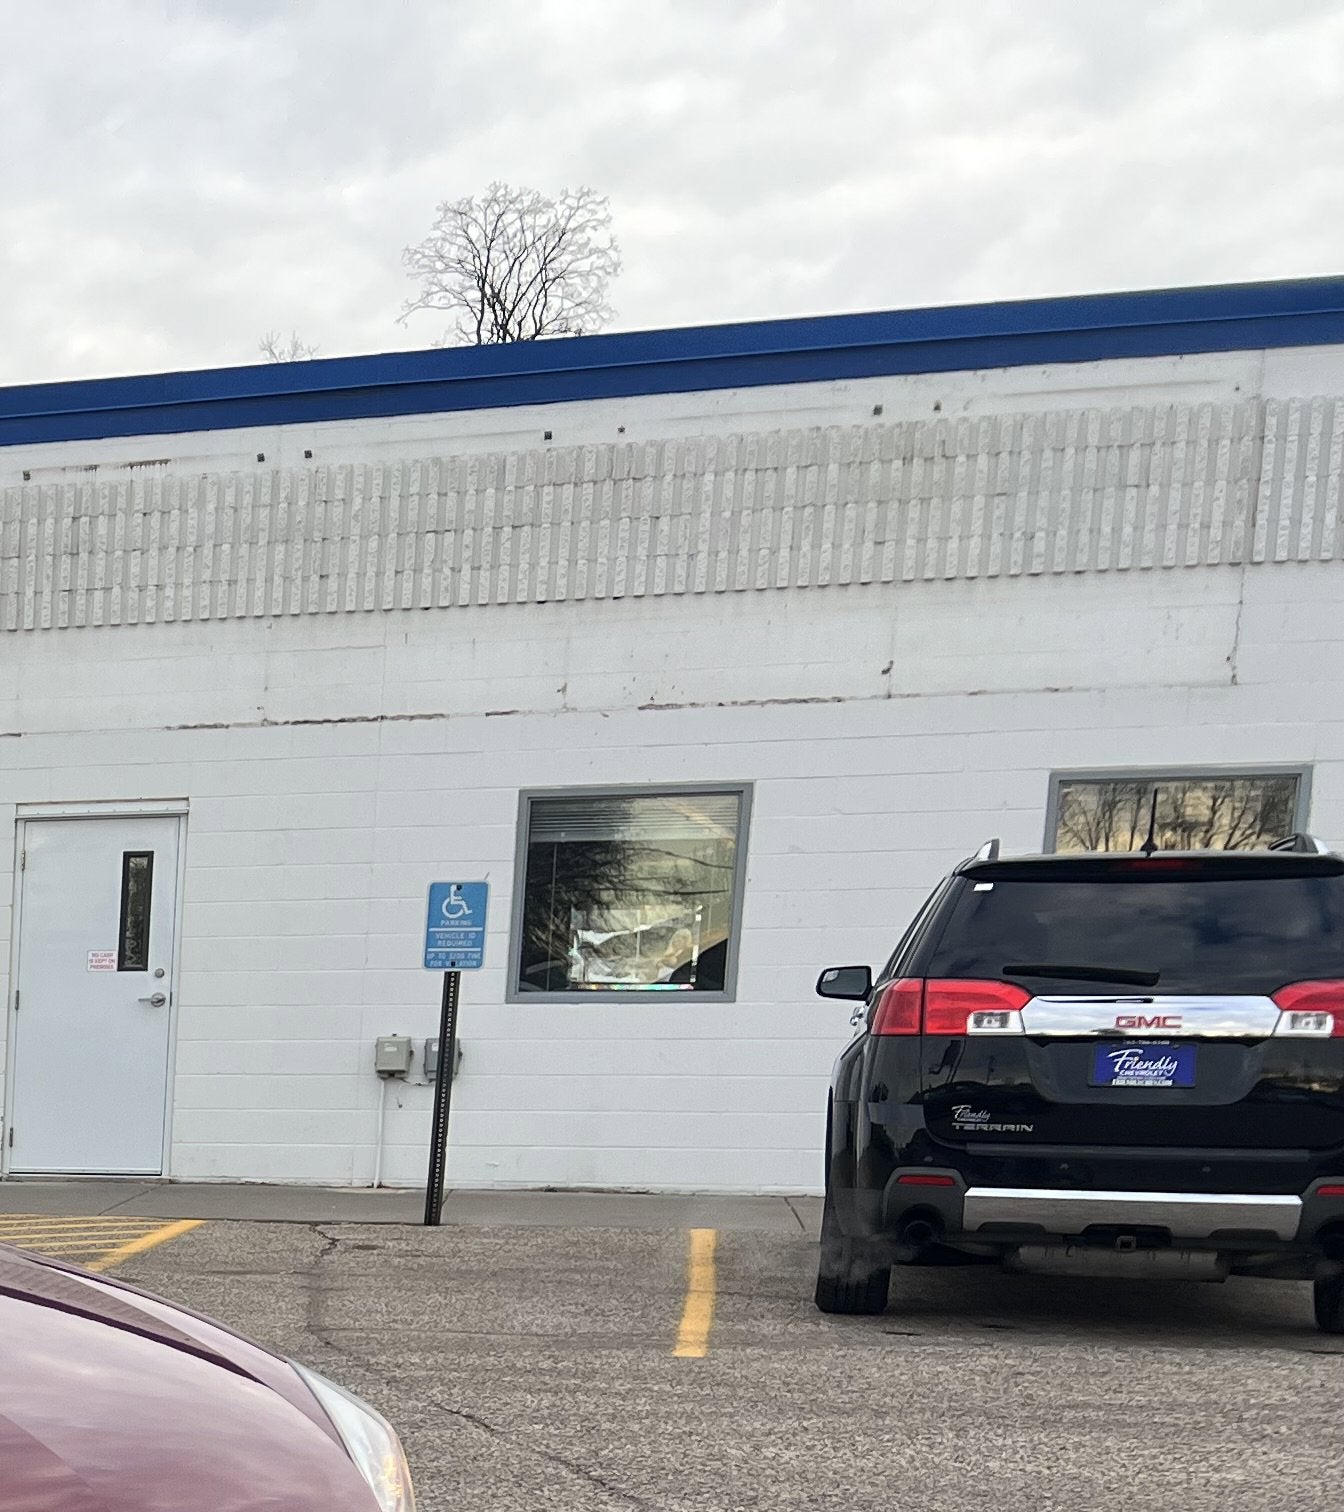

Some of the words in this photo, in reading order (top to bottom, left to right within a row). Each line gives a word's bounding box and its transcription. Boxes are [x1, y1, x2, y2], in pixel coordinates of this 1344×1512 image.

[1115, 1015, 1183, 1028] GMC
[1106, 1048, 1178, 1076] Friendly
[952, 1104, 991, 1122] Friendly
[952, 1122, 1034, 1132] TERRAIN
